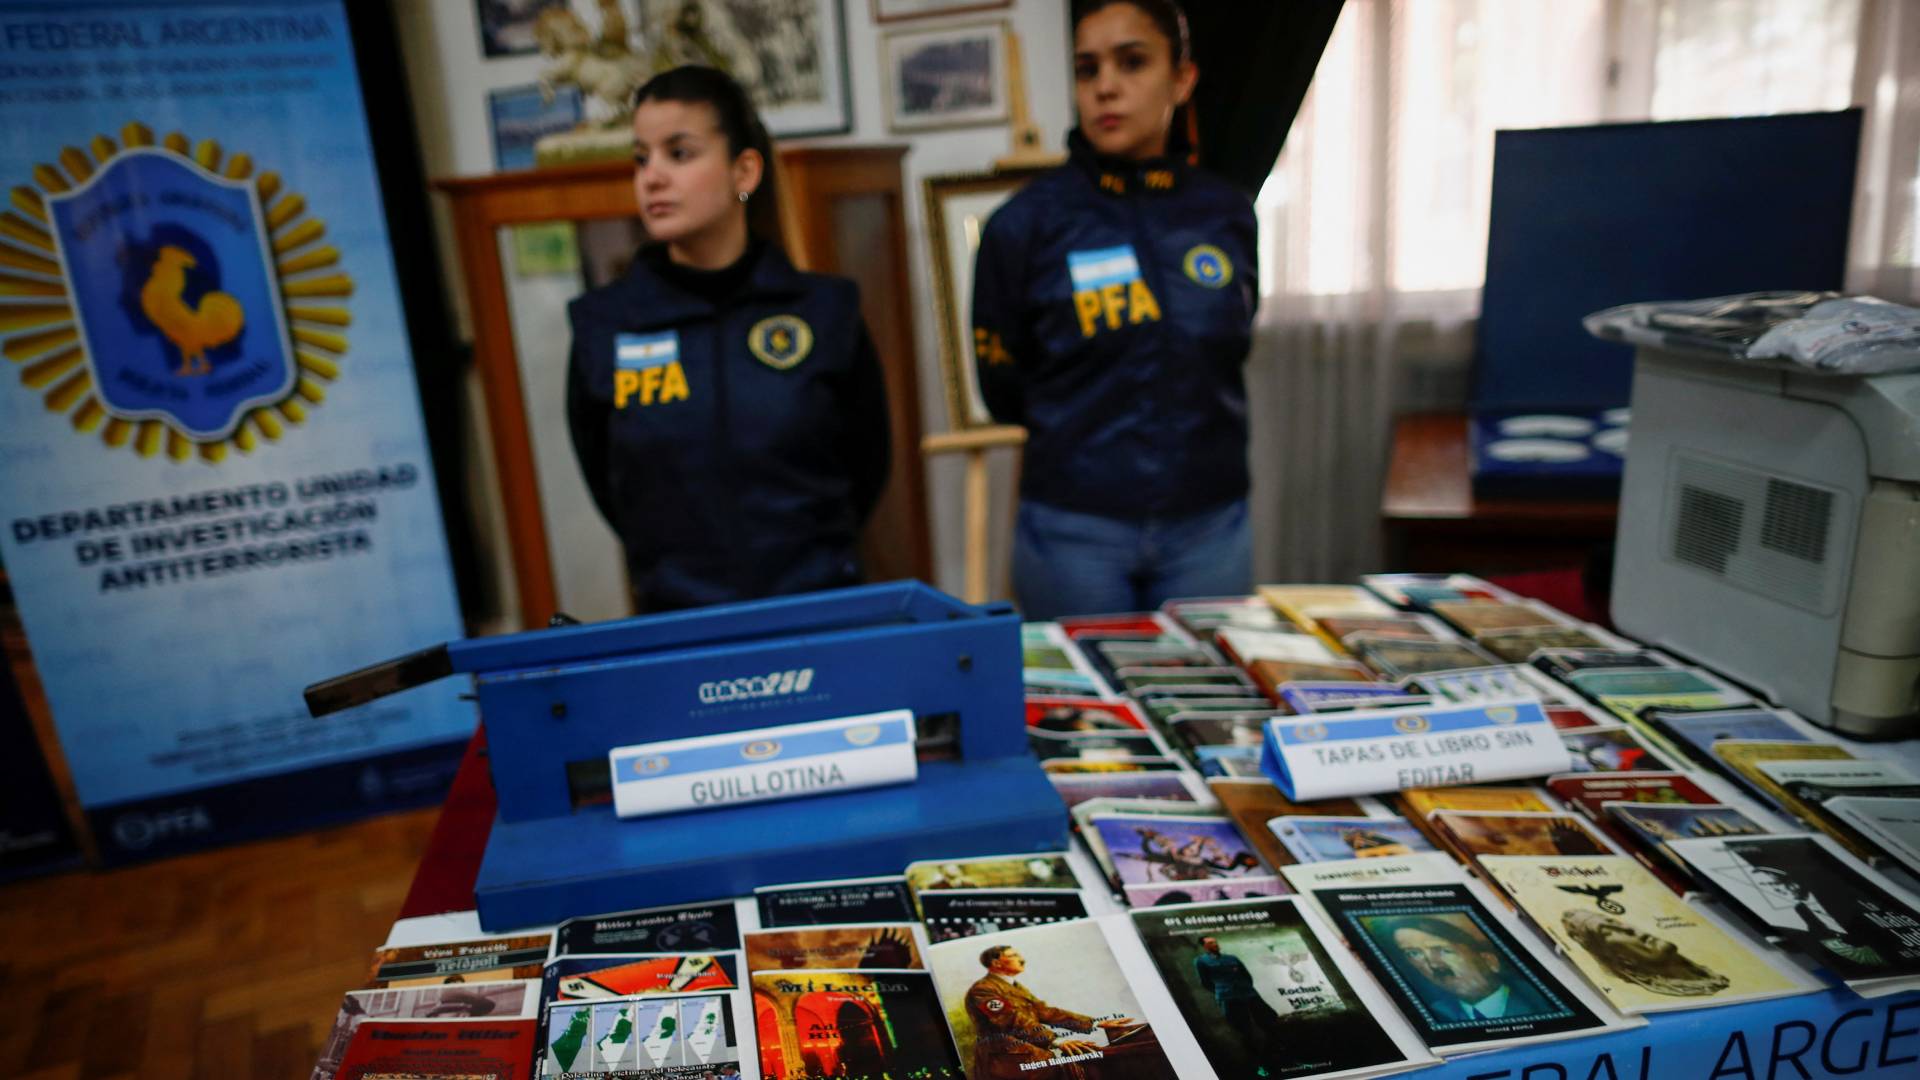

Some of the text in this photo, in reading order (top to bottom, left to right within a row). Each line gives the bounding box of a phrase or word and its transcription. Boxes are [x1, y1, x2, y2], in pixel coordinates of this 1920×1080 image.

[4, 14, 335, 50] FEDERAL ARGENTINA
[1073, 280, 1161, 337] PFA
[614, 361, 690, 409] PFA
[12, 462, 419, 544] DEPARTAMENTO UNIDAD
[76, 498, 379, 567] DE INVESTIGACIÓN
[99, 530, 372, 594] ANTITERRORISTA
[1313, 729, 1534, 765] TAPAS DE LIBRO SIN
[691, 763, 845, 805] GUILLOTINA
[1397, 763, 1475, 788] EDITAR
[777, 979, 815, 992] Mi
[1278, 984, 1322, 996] Rochus
[1288, 996, 1325, 1007] Misch
[1708, 1000, 1920, 1080] ARGE
[650, 1067, 664, 1076] del
[667, 1064, 716, 1073] holocausto
[1019, 1050, 1104, 1072] Eugen Hadamovsky
